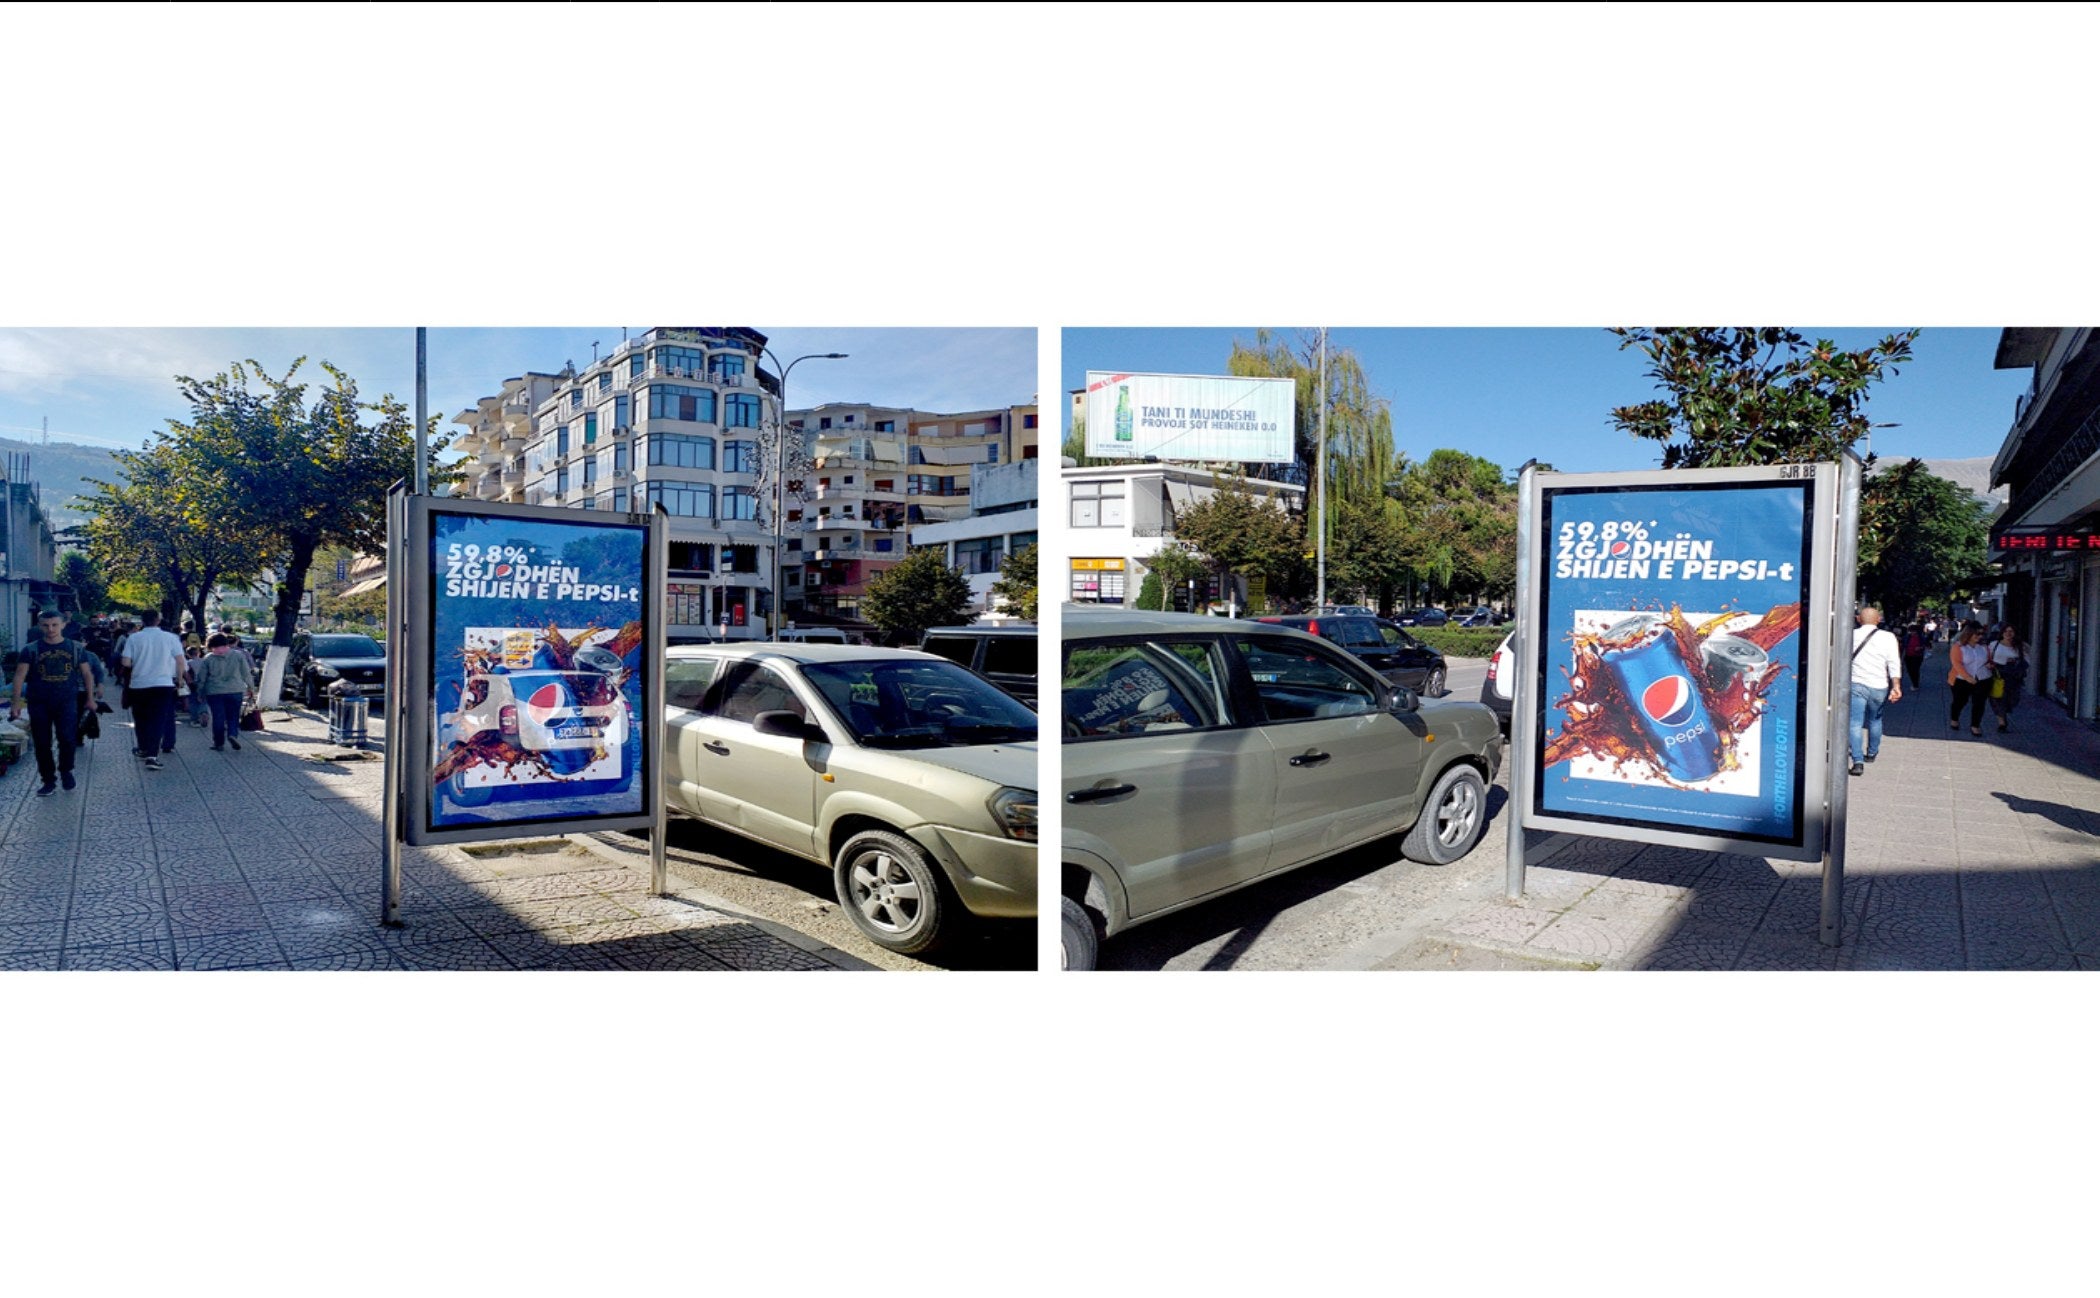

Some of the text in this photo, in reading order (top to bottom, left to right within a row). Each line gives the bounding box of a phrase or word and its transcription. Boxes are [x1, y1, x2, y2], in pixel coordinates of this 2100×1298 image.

[1142, 406, 1171, 419] TANI
[1174, 407, 1186, 419] TI
[1141, 418, 1277, 432] PROVOJE SOT HEINEKEN 0.0
[1555, 559, 1794, 581] SHIJEN E PEPSI-t
[445, 579, 639, 602] SHIJEN E PEPSI-t
[1664, 720, 1706, 749] pepsi
